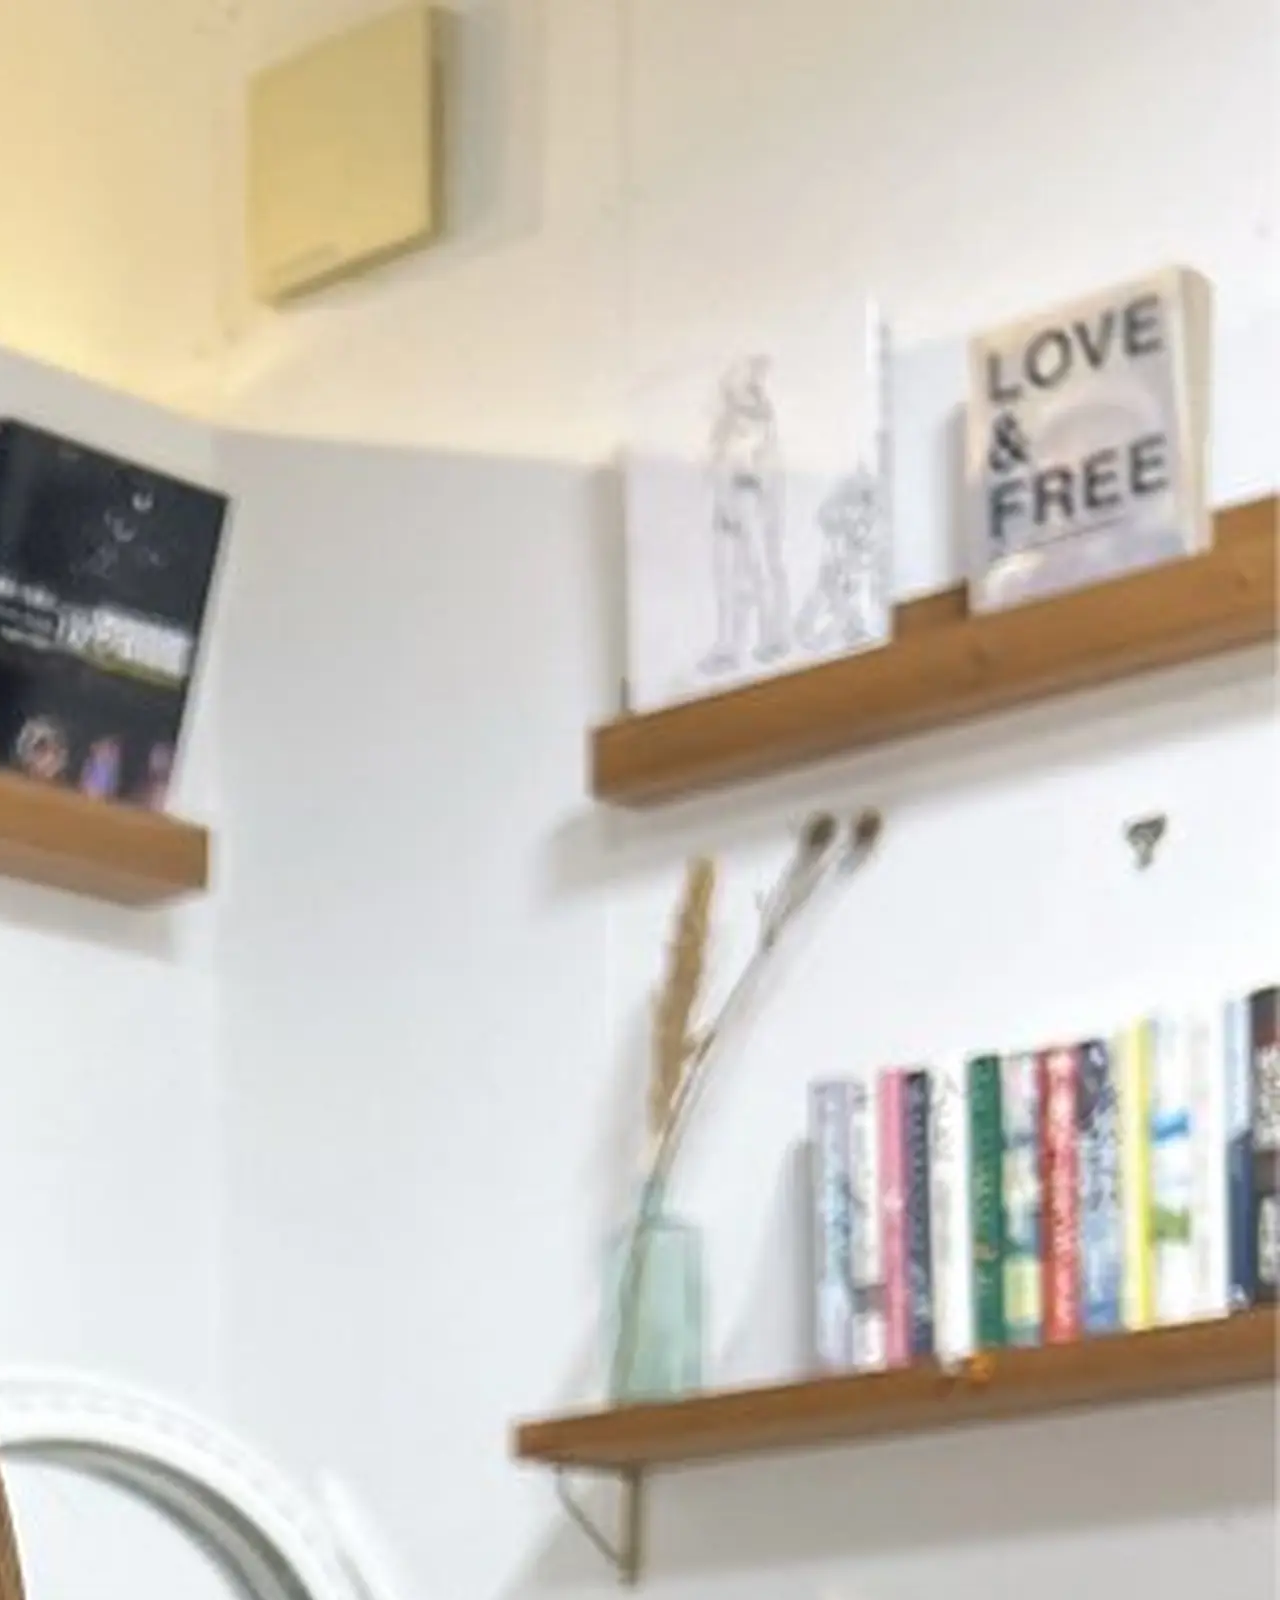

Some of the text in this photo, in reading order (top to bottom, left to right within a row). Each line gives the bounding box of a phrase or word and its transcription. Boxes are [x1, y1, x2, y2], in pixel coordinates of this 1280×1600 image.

[987, 294, 1163, 399] LOVE
[989, 411, 1028, 471] &
[989, 435, 1168, 538] FREE
